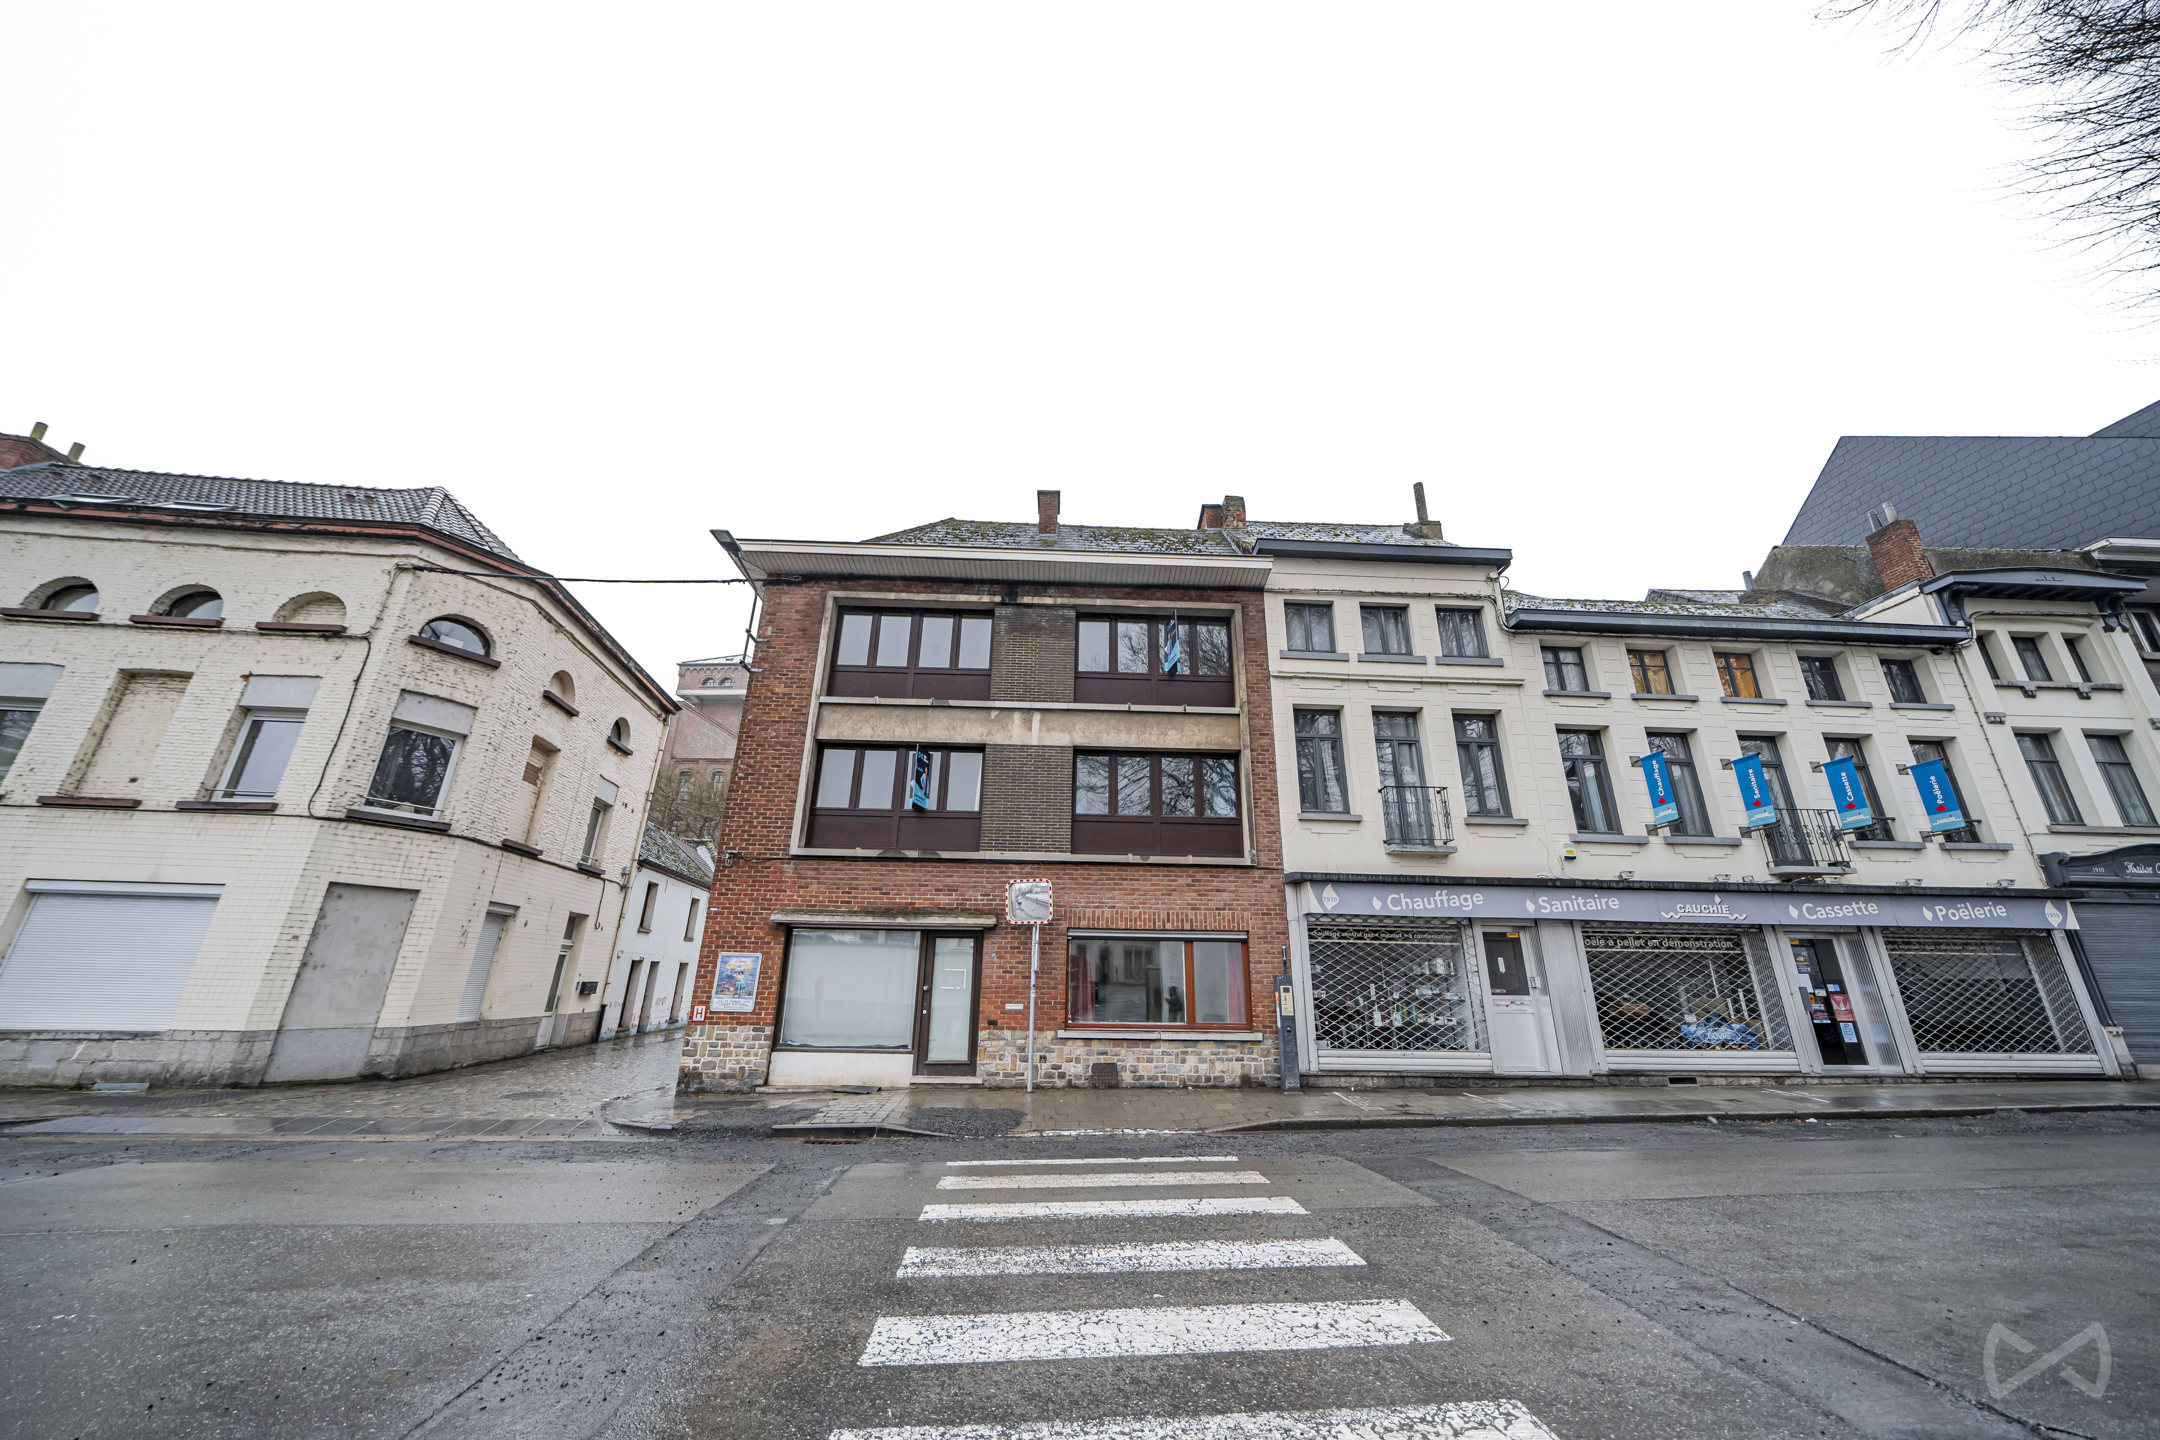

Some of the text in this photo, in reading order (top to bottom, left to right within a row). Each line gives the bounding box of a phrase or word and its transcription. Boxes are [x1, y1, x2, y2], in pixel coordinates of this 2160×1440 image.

[1652, 760, 1665, 796] Chauffage
[1748, 768, 1761, 799] Sanitaire
[1841, 771, 1854, 802] Cassette
[1929, 775, 1945, 805] Poëlerie
[1386, 890, 1484, 911] Chauffage
[1538, 894, 1620, 913] Sanitaire
[1676, 903, 1731, 915] CAUCHIE
[1802, 900, 1879, 920] Cassette
[1935, 902, 2007, 922] Poëlerie
[1584, 936, 1605, 946] oële
[1661, 938, 1733, 948] démonstration
